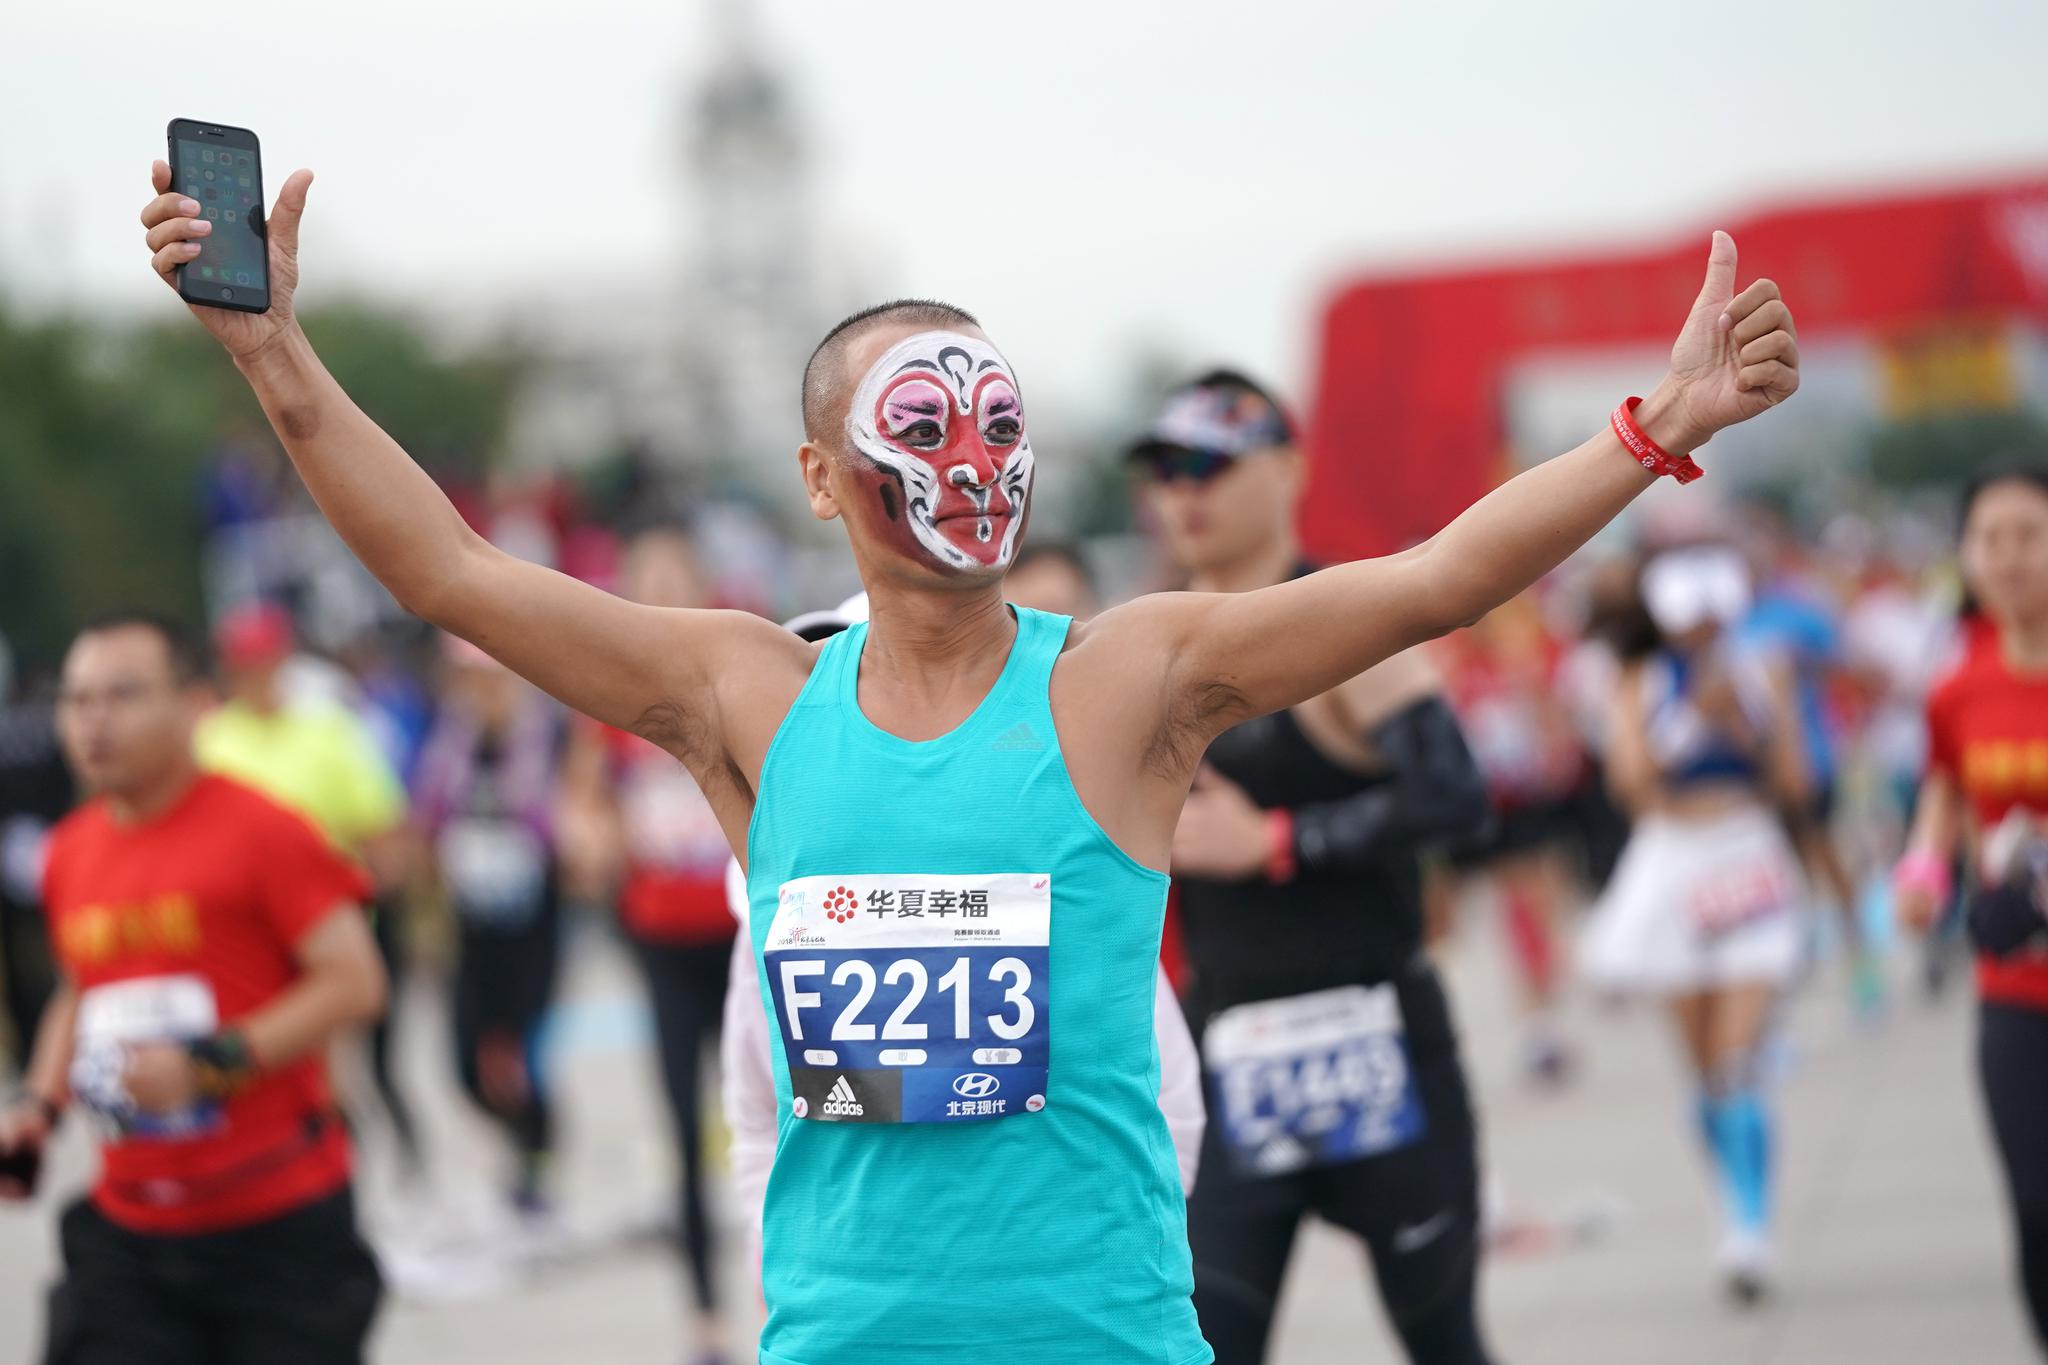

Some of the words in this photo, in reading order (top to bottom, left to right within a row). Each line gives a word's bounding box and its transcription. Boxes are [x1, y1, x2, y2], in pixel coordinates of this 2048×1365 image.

[866, 889, 989, 919] 华夏幸福
[780, 957, 1035, 1040] F2213
[823, 1100, 864, 1116] adidas
[946, 1099, 1007, 1116] 北京现代
